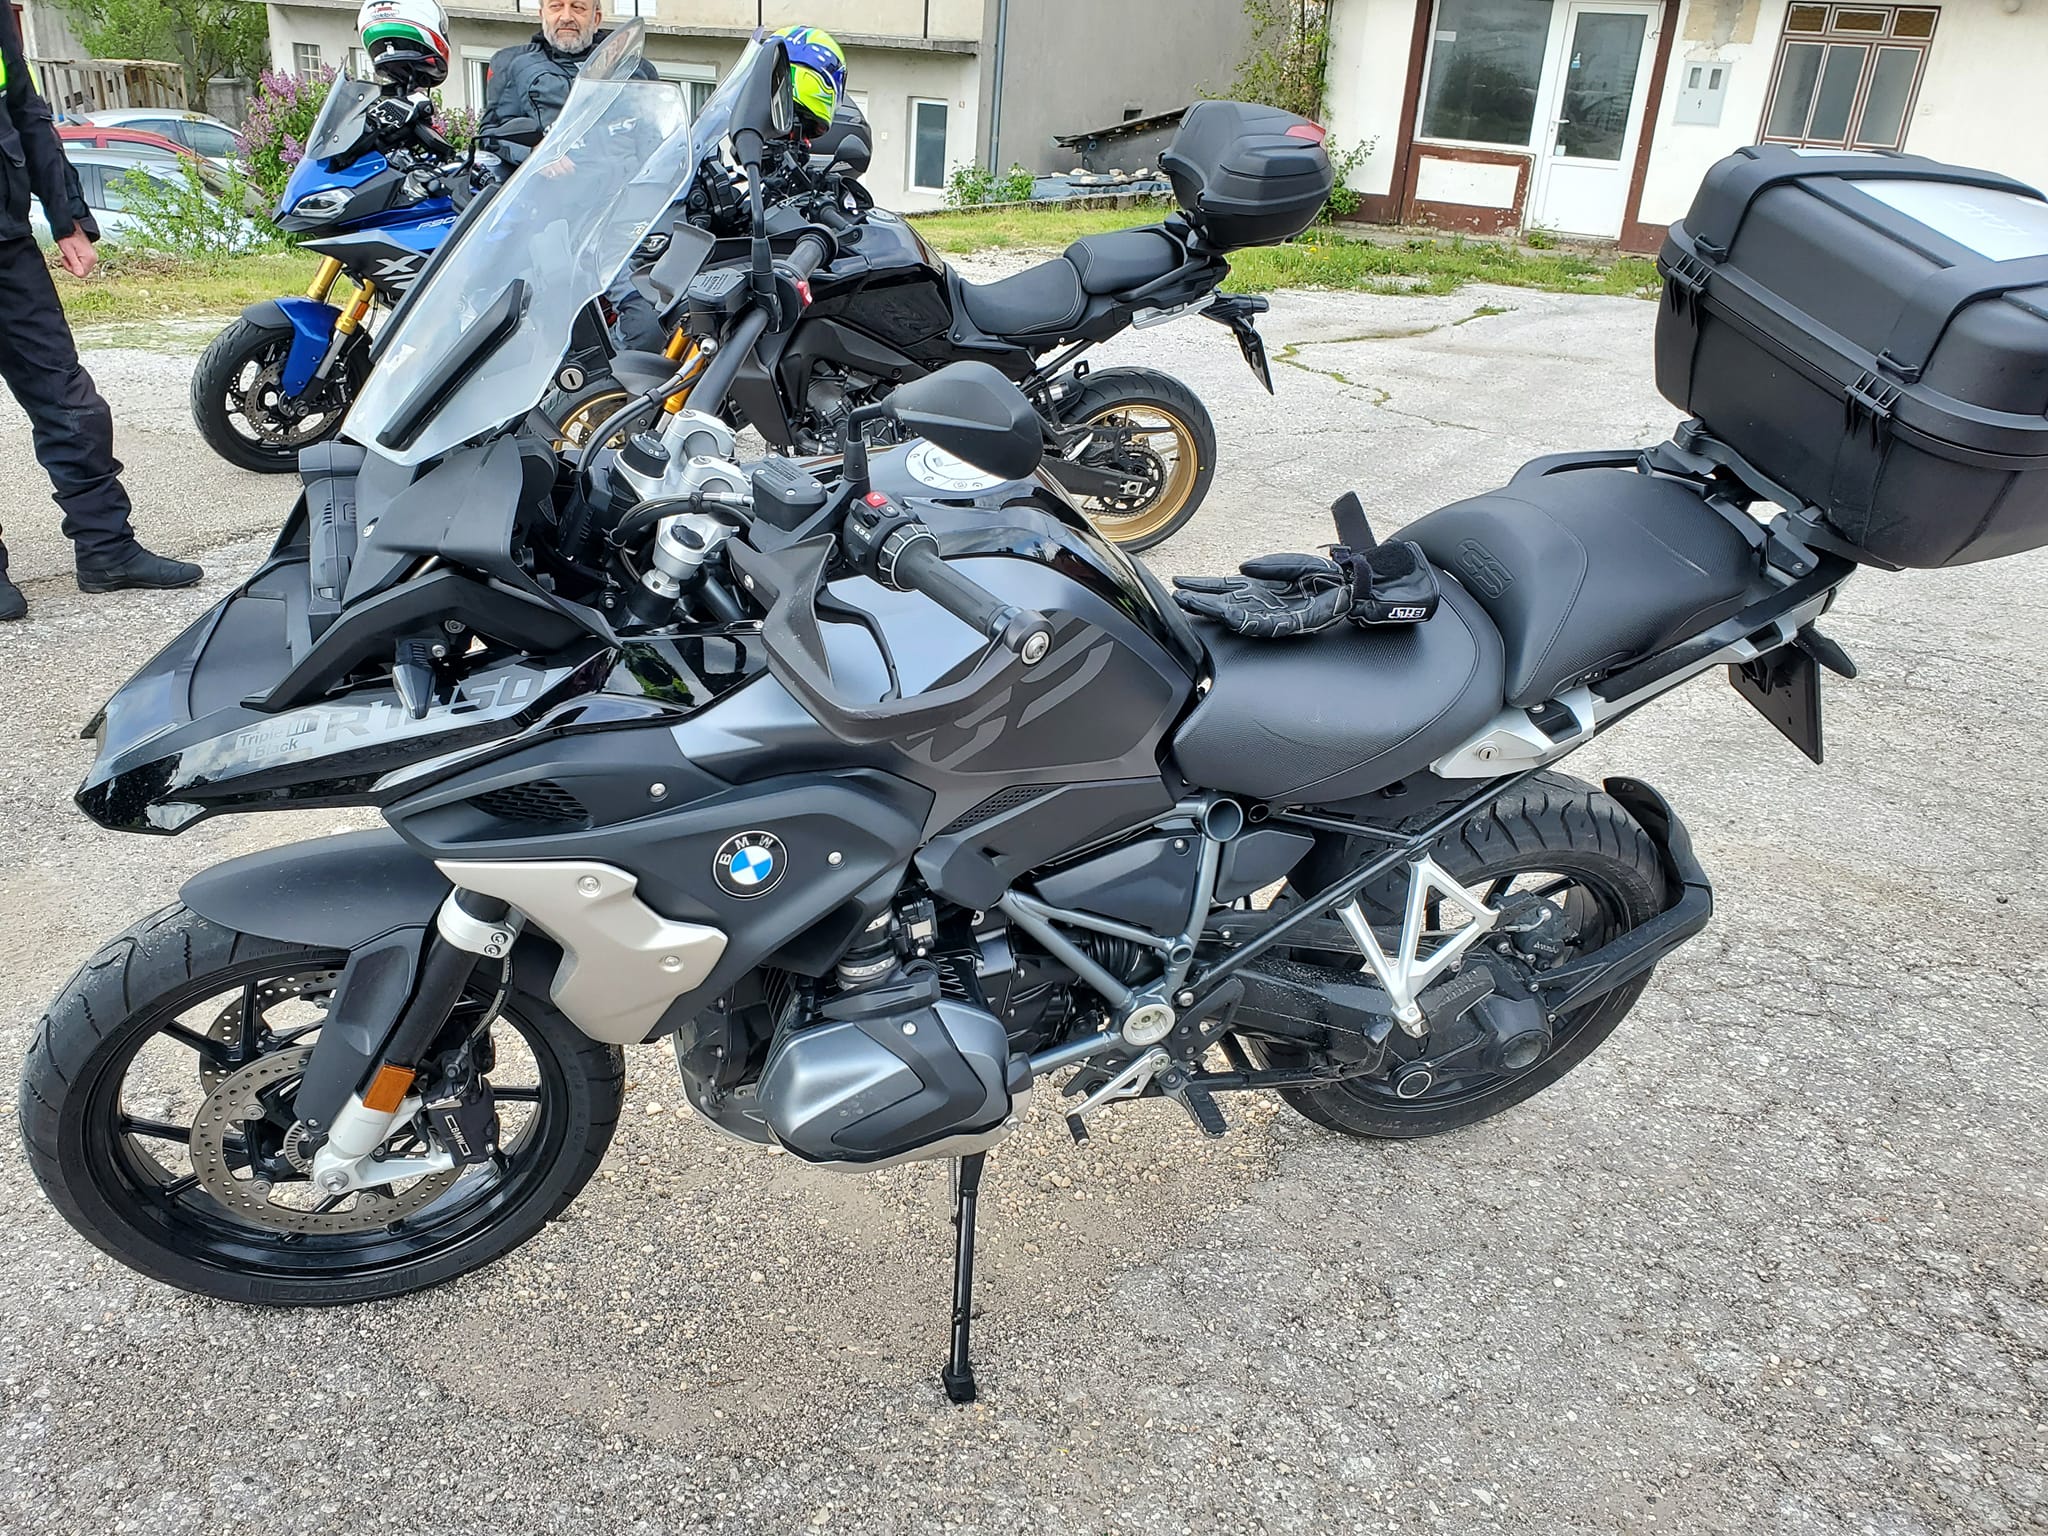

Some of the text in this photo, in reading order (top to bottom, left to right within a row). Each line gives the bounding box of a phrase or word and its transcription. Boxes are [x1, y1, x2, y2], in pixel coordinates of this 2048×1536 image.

[416, 215, 460, 231] F90
[323, 670, 543, 743] R150
[240, 727, 282, 747] Triple
[254, 737, 298, 758] Black
[718, 835, 774, 866] BMW
